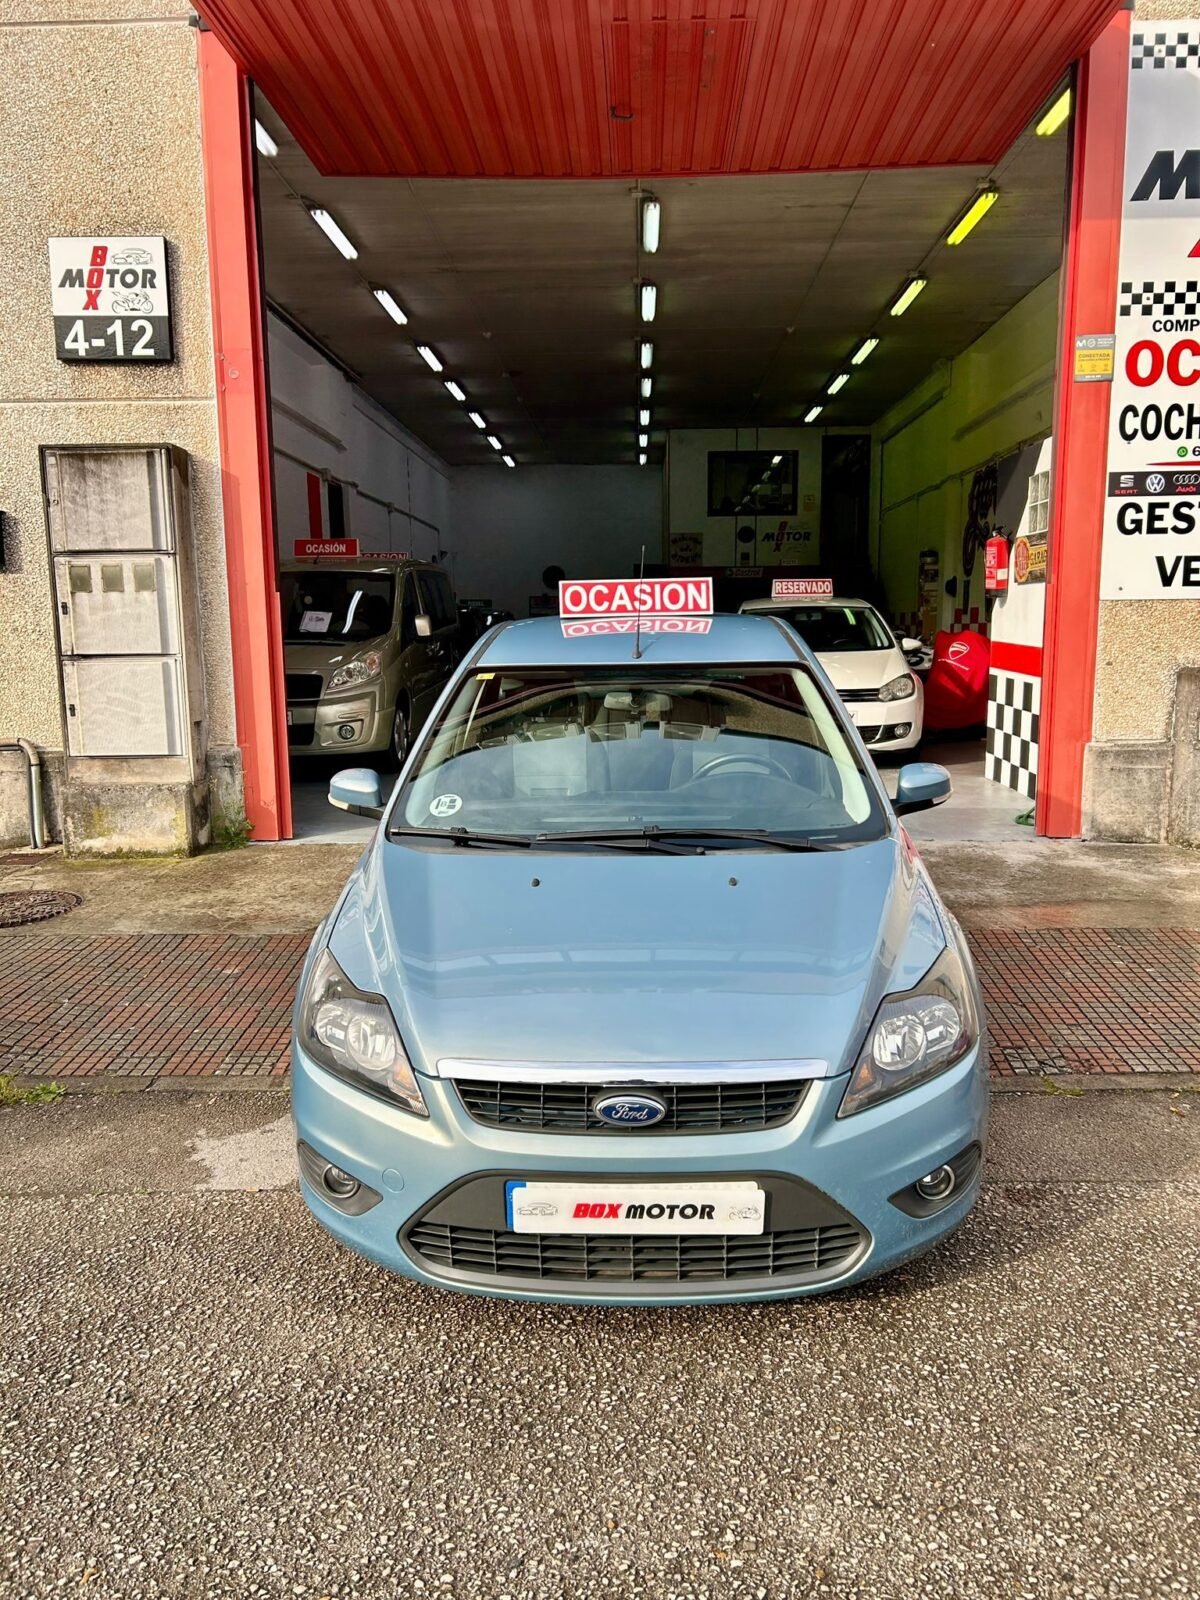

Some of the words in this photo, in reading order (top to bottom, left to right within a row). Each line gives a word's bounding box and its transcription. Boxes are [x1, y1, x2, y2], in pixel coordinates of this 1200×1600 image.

[58, 268, 157, 289] MOTOR
[1152, 319, 1200, 333] COMP
[64, 319, 155, 356] 4-12
[1116, 501, 1200, 536] GES
[305, 542, 346, 553] OCASIÓN
[775, 581, 831, 593] RESERVADO
[564, 583, 708, 612] OCASION
[612, 1103, 648, 1120] Ford
[572, 1203, 623, 1219] BOX
[625, 1204, 715, 1220] MOTOR
